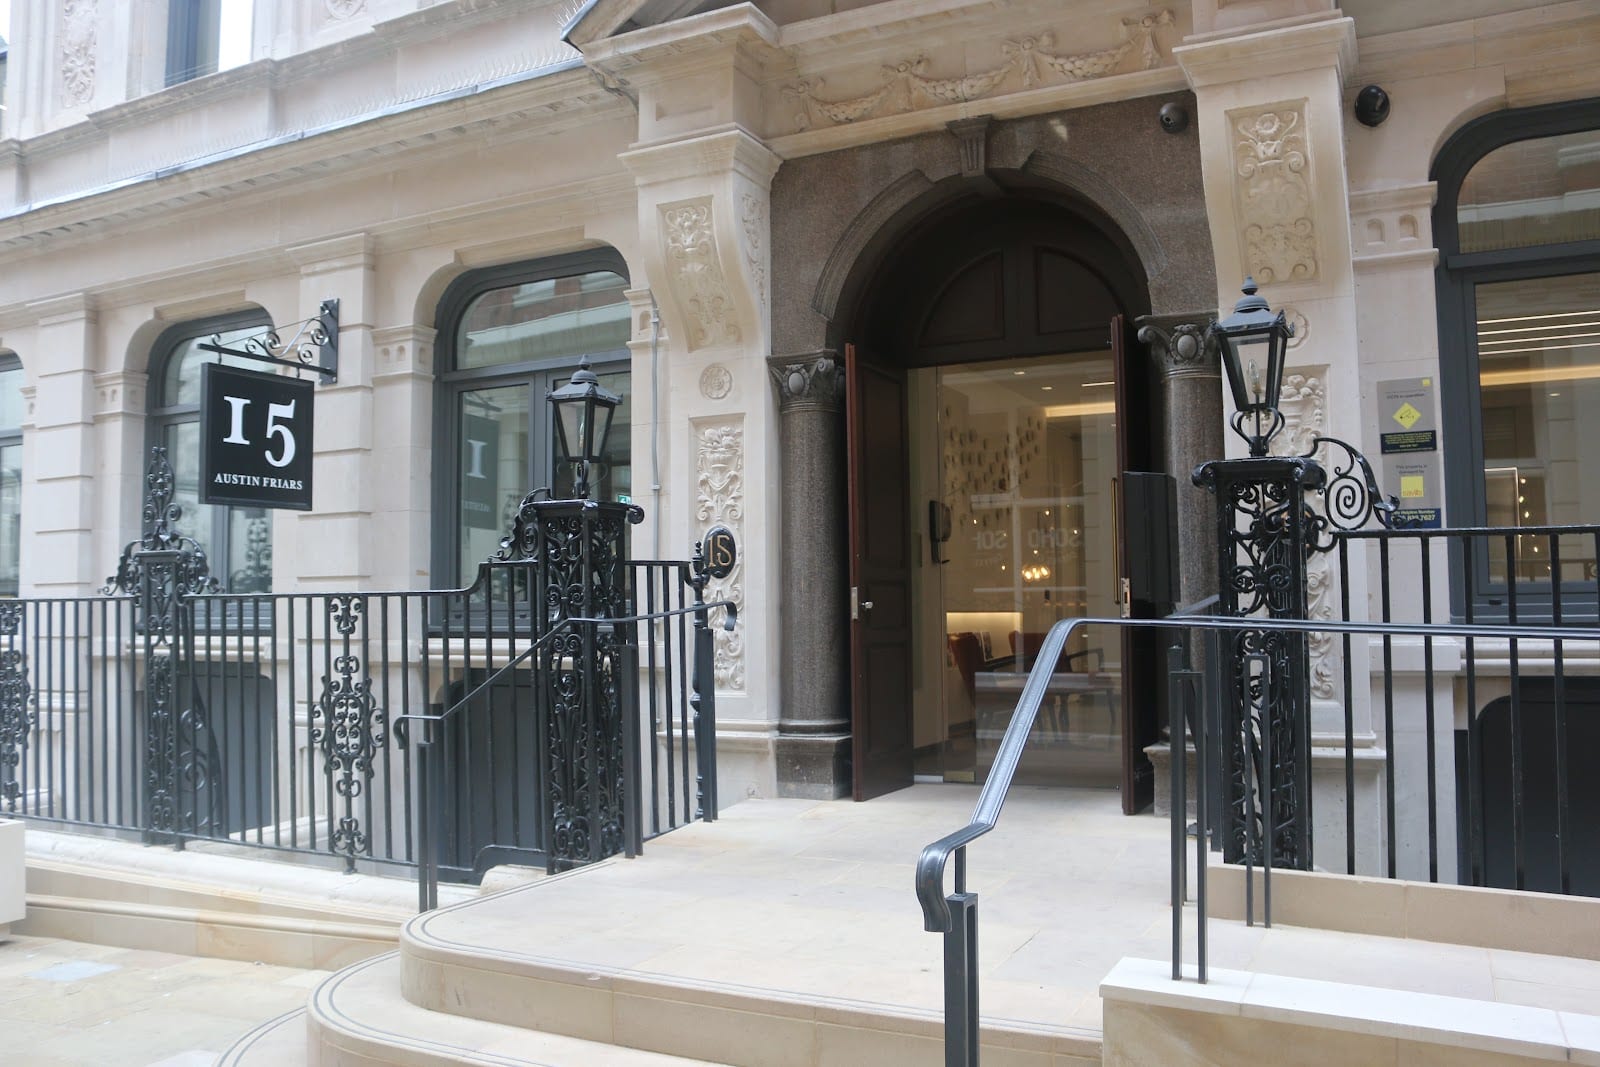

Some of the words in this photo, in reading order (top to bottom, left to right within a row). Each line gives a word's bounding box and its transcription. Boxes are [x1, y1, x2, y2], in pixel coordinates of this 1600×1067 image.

[214, 473, 260, 486] AUSTIN
[263, 477, 303, 490] FRIARS
[708, 534, 732, 567] 15
